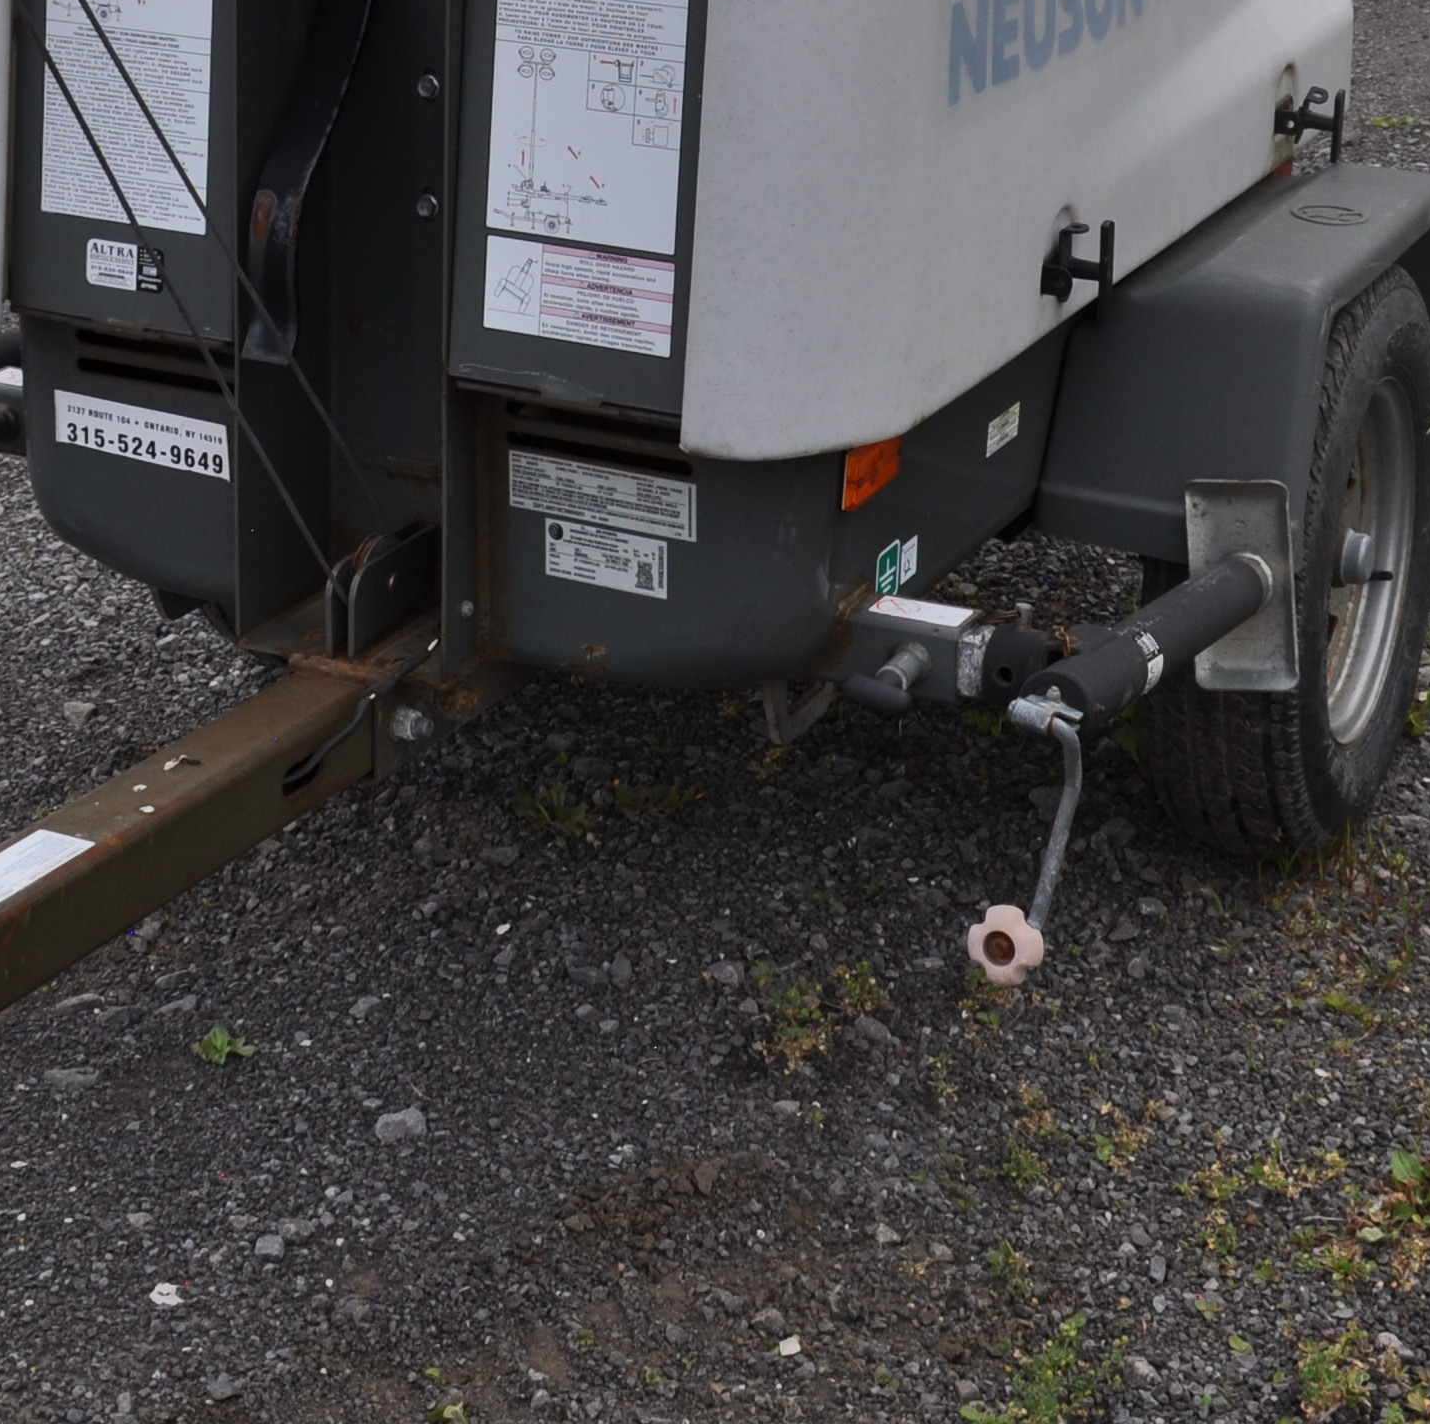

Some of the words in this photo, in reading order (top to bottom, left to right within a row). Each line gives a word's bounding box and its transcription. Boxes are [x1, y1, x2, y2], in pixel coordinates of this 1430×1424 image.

[91, 242, 134, 258] ALTRA
[586, 282, 633, 295] ADVERTENCIA
[581, 312, 635, 327] AVERTISSEMENT
[67, 405, 85, 416] 2127
[88, 408, 113, 421] ROUTE
[116, 415, 131, 425] 104
[144, 421, 182, 437] ONTARIO,
[185, 430, 196, 438] NY
[199, 433, 223, 445] 14519
[67, 423, 223, 474] 315-524-9649
